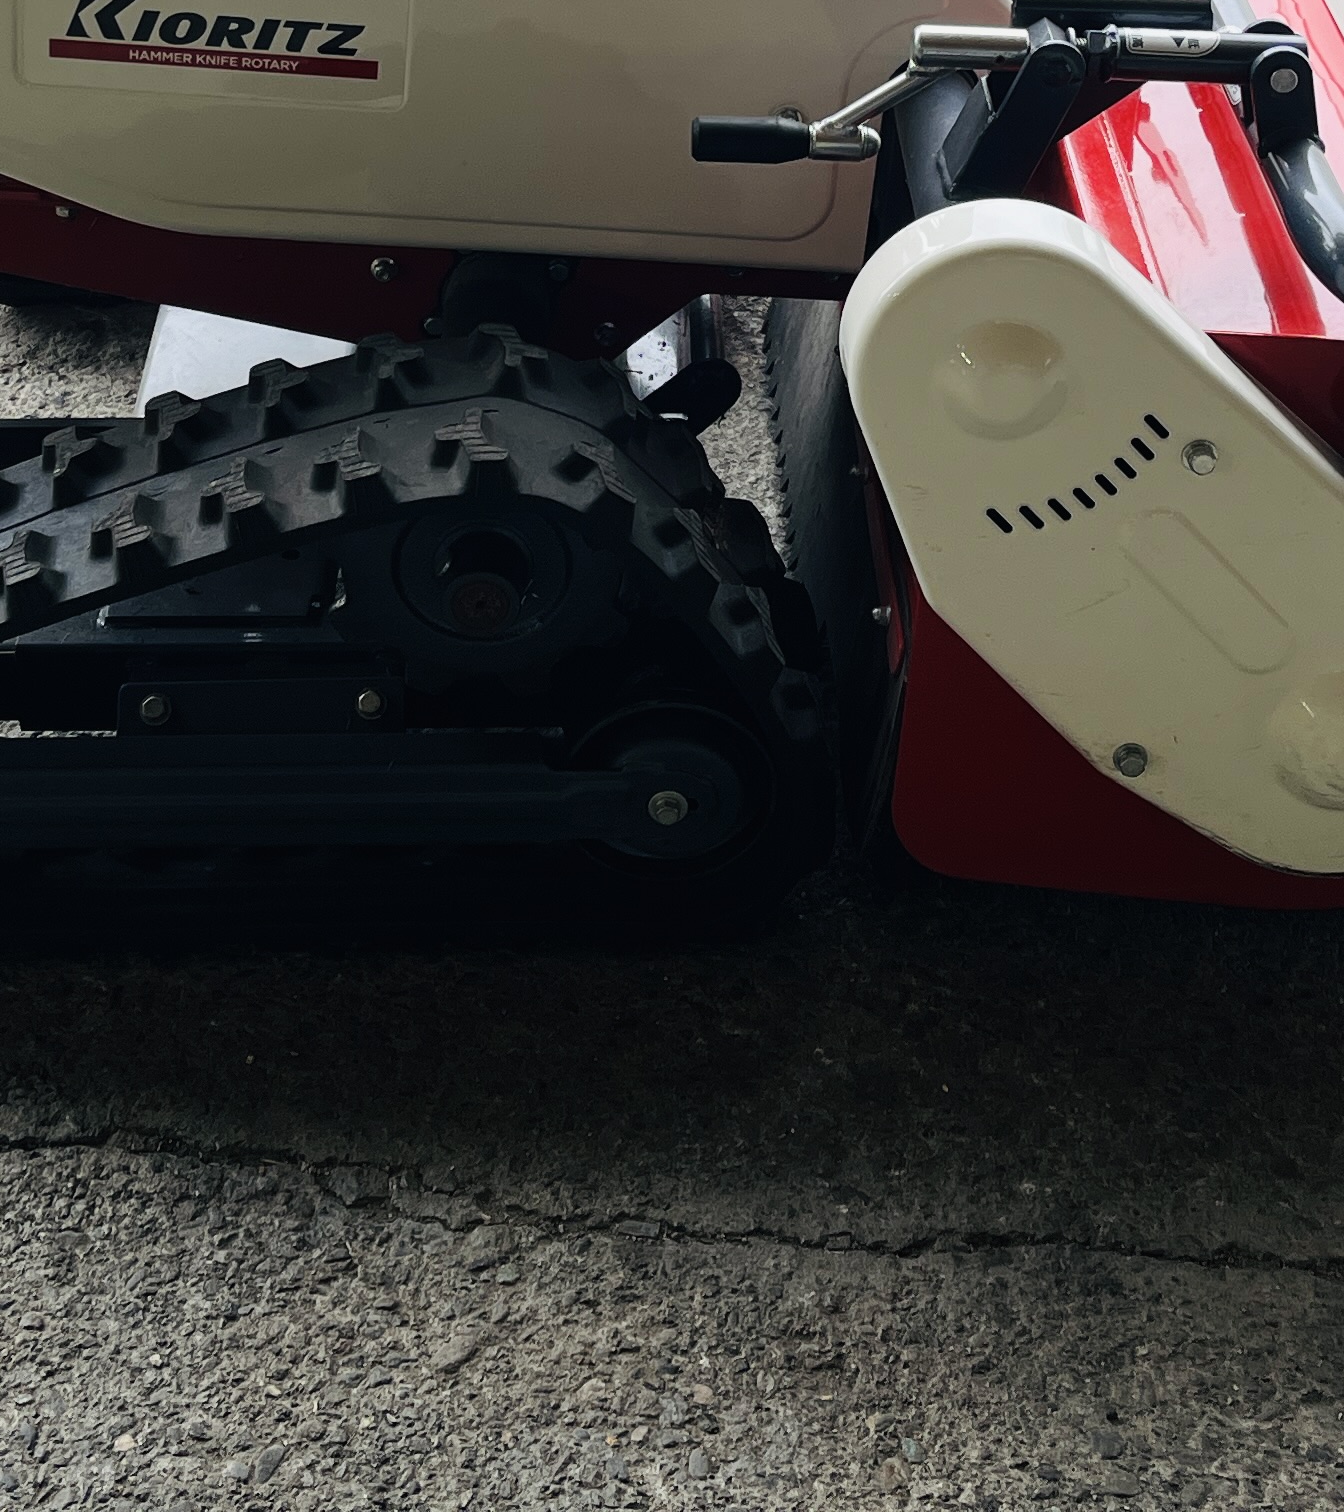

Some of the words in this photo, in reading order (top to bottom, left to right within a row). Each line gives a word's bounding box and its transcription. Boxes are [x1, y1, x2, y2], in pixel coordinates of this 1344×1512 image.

[128, 48, 193, 65] HAMMER
[195, 52, 239, 68] KNIFE
[241, 56, 300, 73] ROTARY
